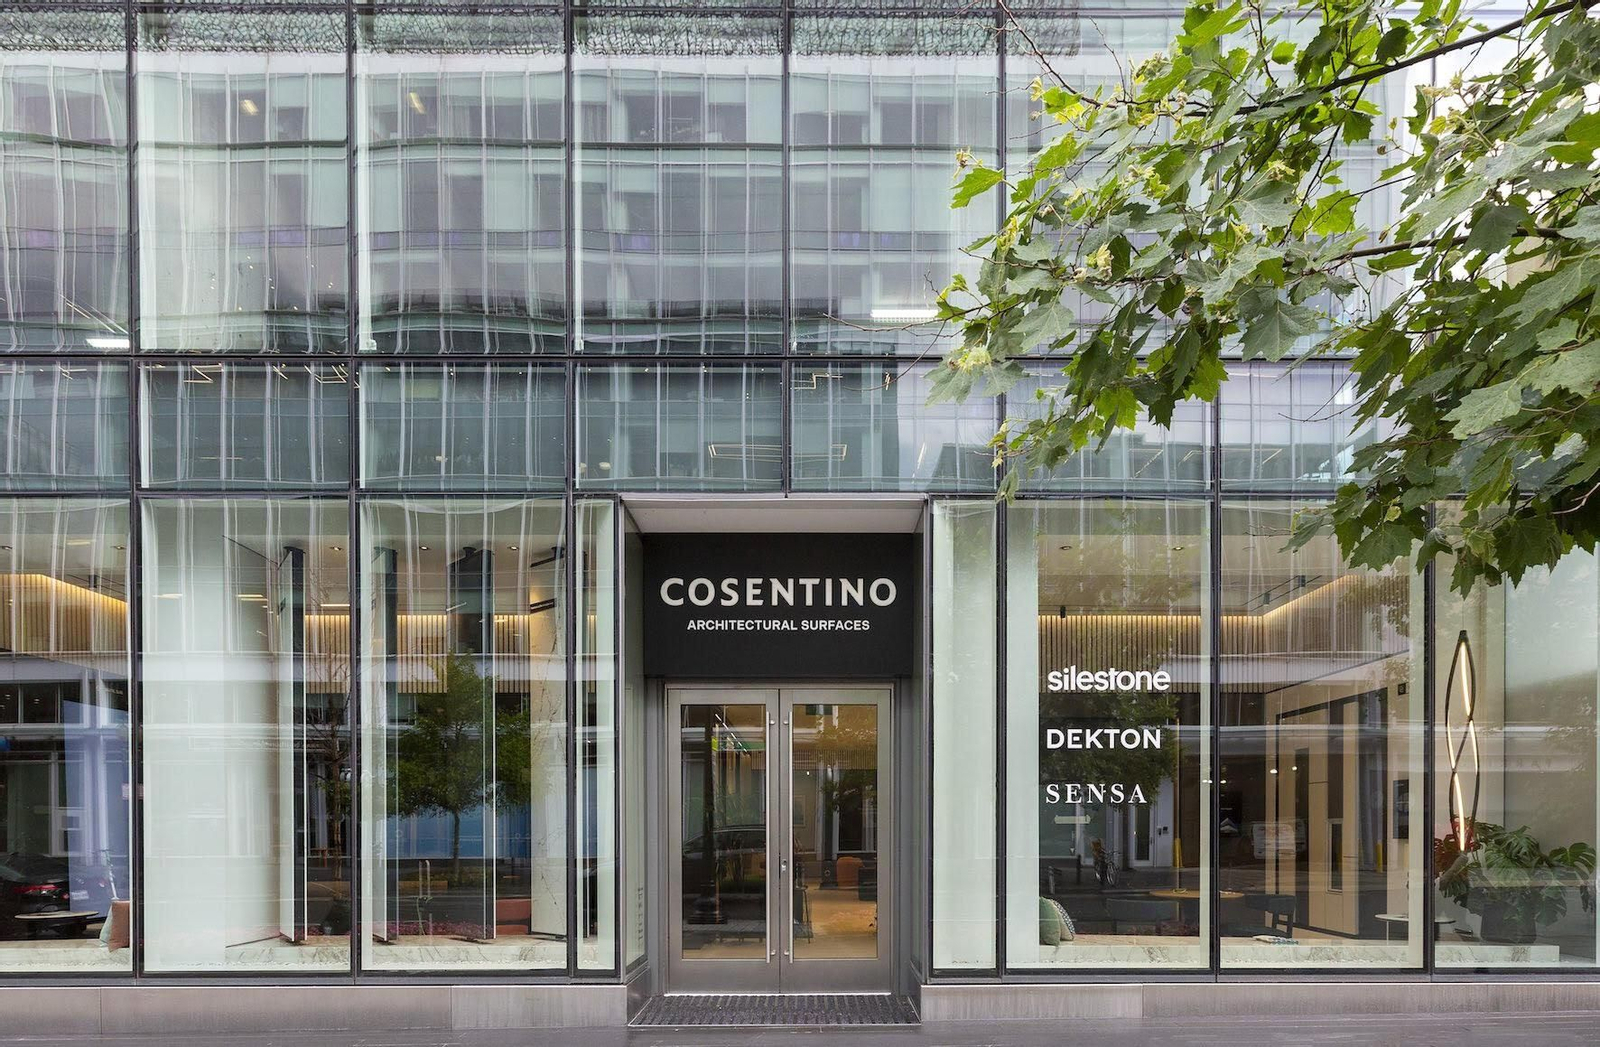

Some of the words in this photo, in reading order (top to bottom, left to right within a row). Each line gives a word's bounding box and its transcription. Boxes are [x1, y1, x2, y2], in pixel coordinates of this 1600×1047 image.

[660, 577, 897, 607] COSENTINO
[687, 619, 798, 631] ARCHITECTURAL
[800, 619, 870, 631] SURFACES
[1047, 664, 1171, 691] silestone
[1046, 728, 1161, 749] DEKTON
[1045, 783, 1147, 804] SENSA
